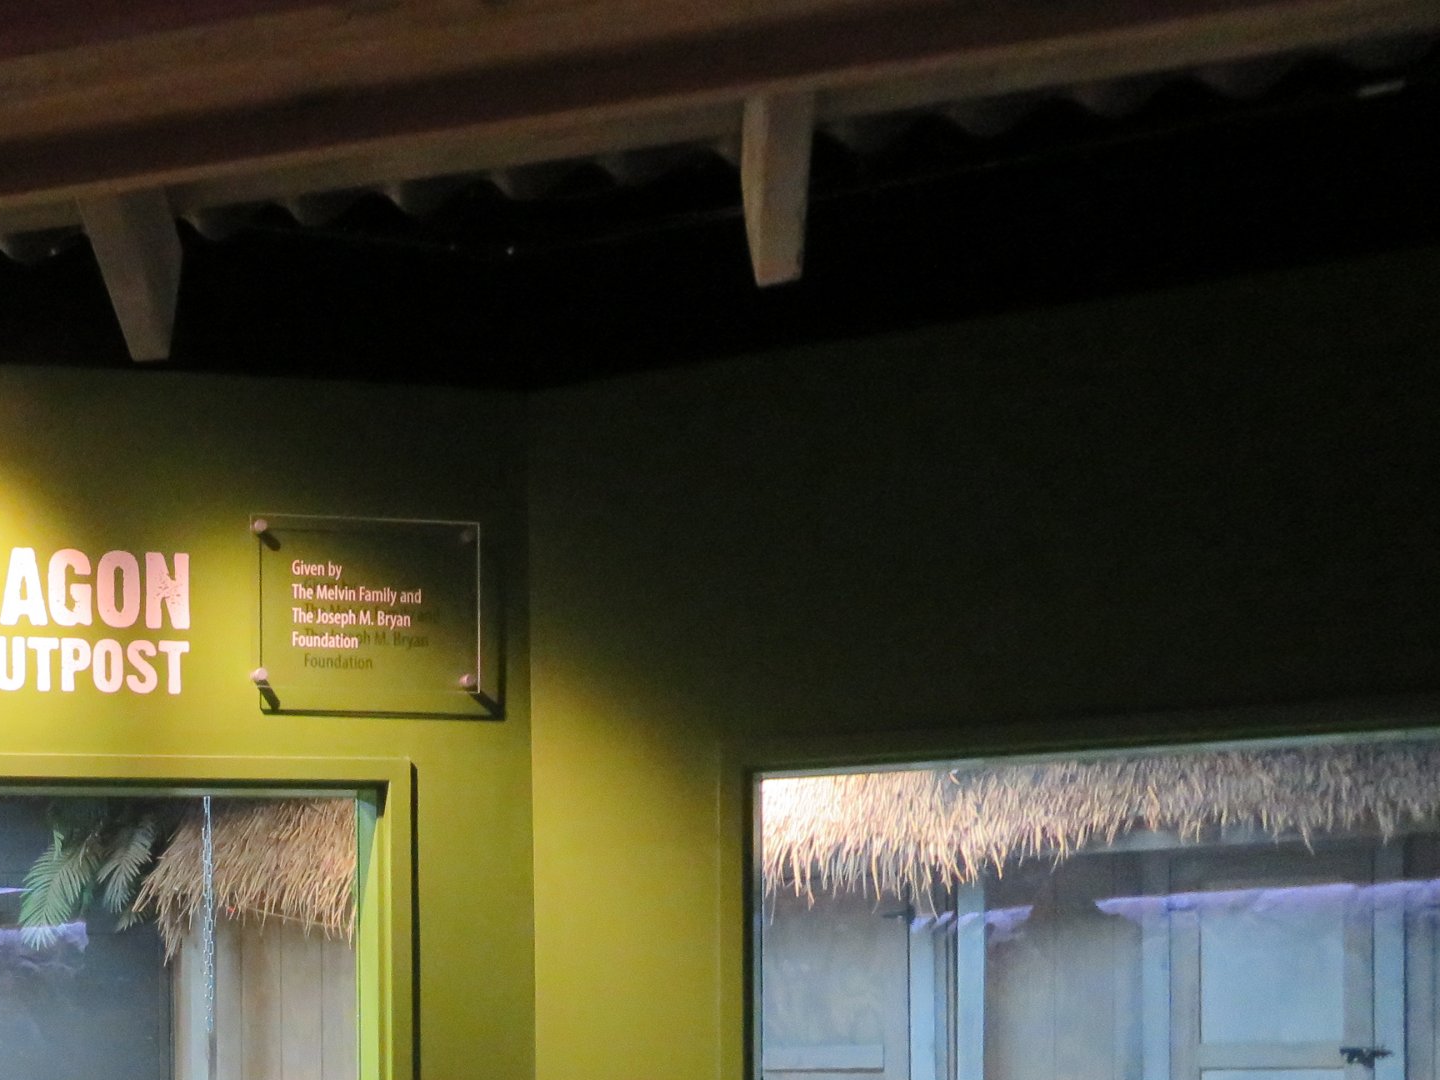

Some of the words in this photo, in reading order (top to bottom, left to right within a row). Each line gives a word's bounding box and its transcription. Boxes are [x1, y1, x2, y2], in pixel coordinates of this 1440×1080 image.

[292, 559, 324, 577] Given
[328, 561, 342, 580] by
[292, 583, 313, 600] The
[317, 584, 355, 601] Melvin
[359, 586, 397, 606] Family
[400, 589, 421, 604] and
[292, 607, 313, 624] The
[316, 608, 356, 628] Joseph
[359, 609, 374, 625] M.
[377, 611, 410, 630] Bryan
[292, 631, 358, 649] Foundation
